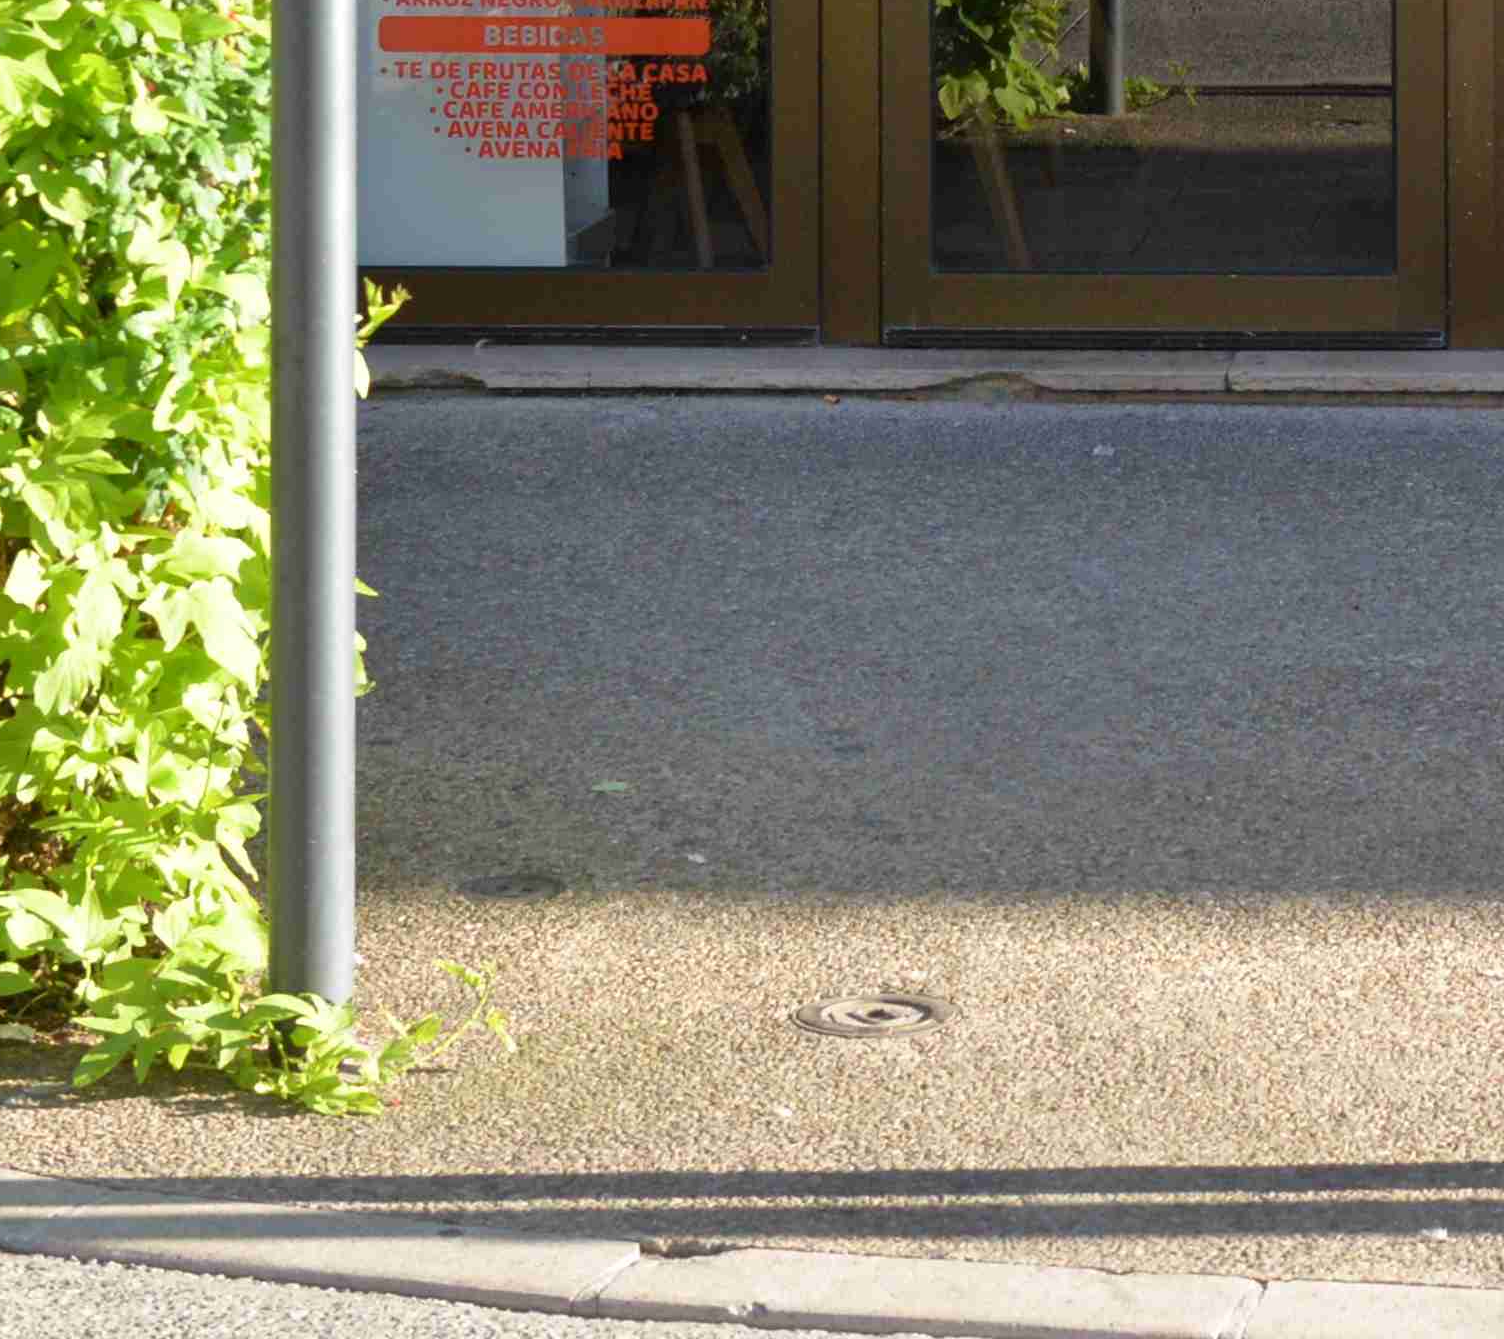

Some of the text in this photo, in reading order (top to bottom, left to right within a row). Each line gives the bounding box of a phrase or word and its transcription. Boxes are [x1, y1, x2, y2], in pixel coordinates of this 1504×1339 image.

[484, 24, 607, 47] BEBIDAS
[394, 61, 708, 83] TE DE FRUTAS DE LA CASA
[450, 82, 511, 101] CAFE
[517, 82, 567, 101] CON
[443, 100, 660, 121] CAFE AMERANO
[447, 120, 654, 141] AVENA CALENTE
[478, 140, 561, 159] AVENA
